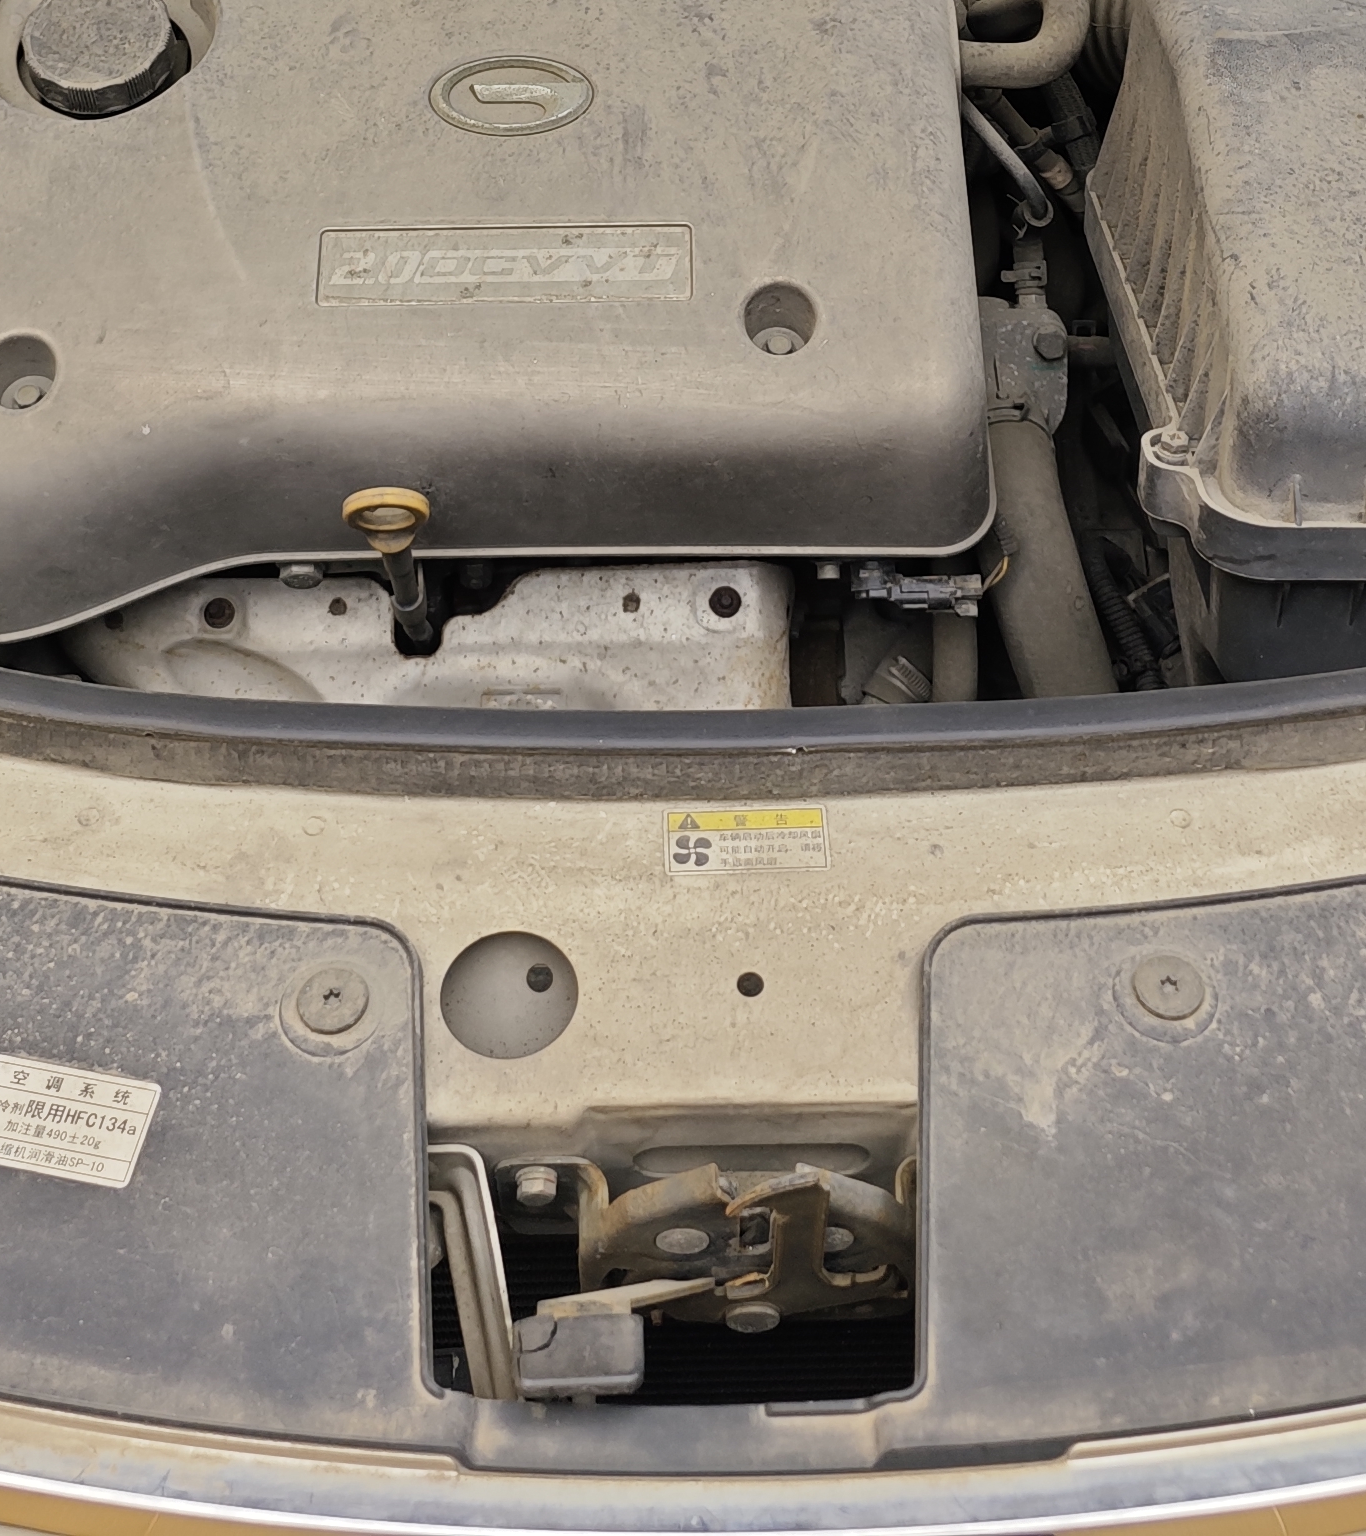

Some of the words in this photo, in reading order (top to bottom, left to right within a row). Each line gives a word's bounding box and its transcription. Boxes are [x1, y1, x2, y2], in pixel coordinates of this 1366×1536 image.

[733, 813, 789, 827] 警告
[9, 1069, 133, 1106] 空调系统
